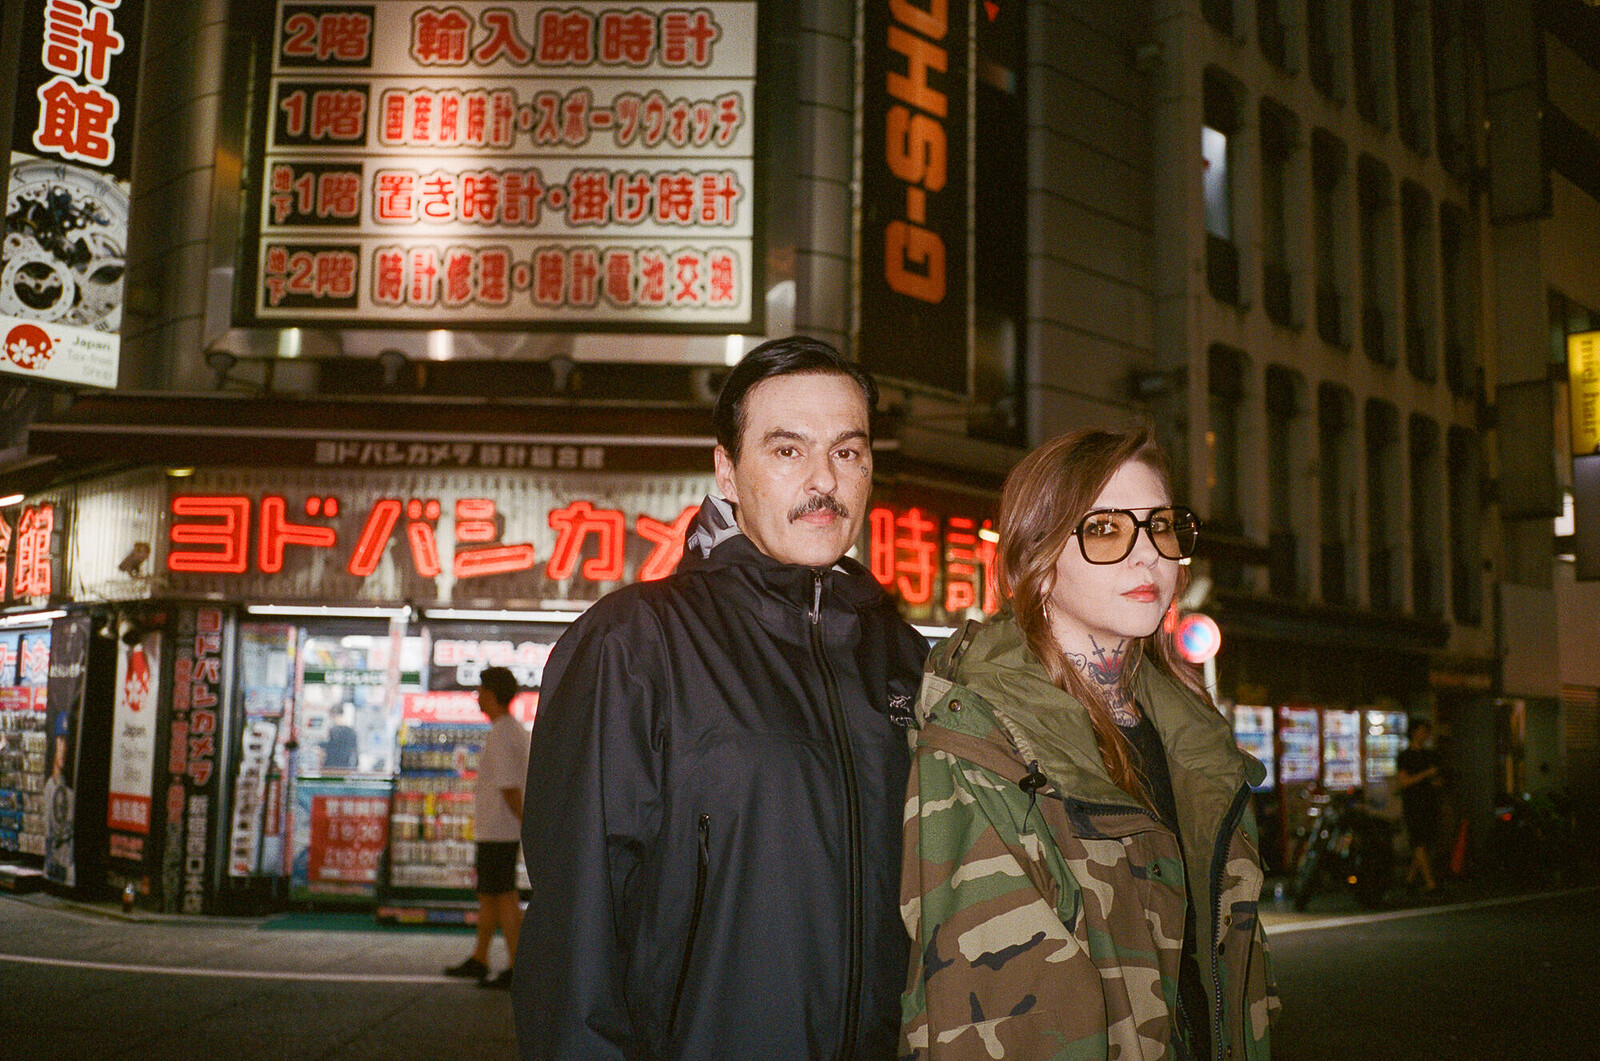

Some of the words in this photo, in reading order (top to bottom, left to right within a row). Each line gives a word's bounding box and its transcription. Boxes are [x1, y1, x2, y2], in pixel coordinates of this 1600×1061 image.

[284, 12, 371, 60] 2階
[412, 8, 720, 66] 輸入腕時計
[34, 0, 123, 164] 計館
[282, 90, 367, 139] 1階
[377, 173, 740, 226] 置き時計・掛け時計
[72, 336, 111, 350] Japan
[168, 496, 701, 582] ヨドバシカメ
[187, 610, 222, 786] ヨドバシカメラ
